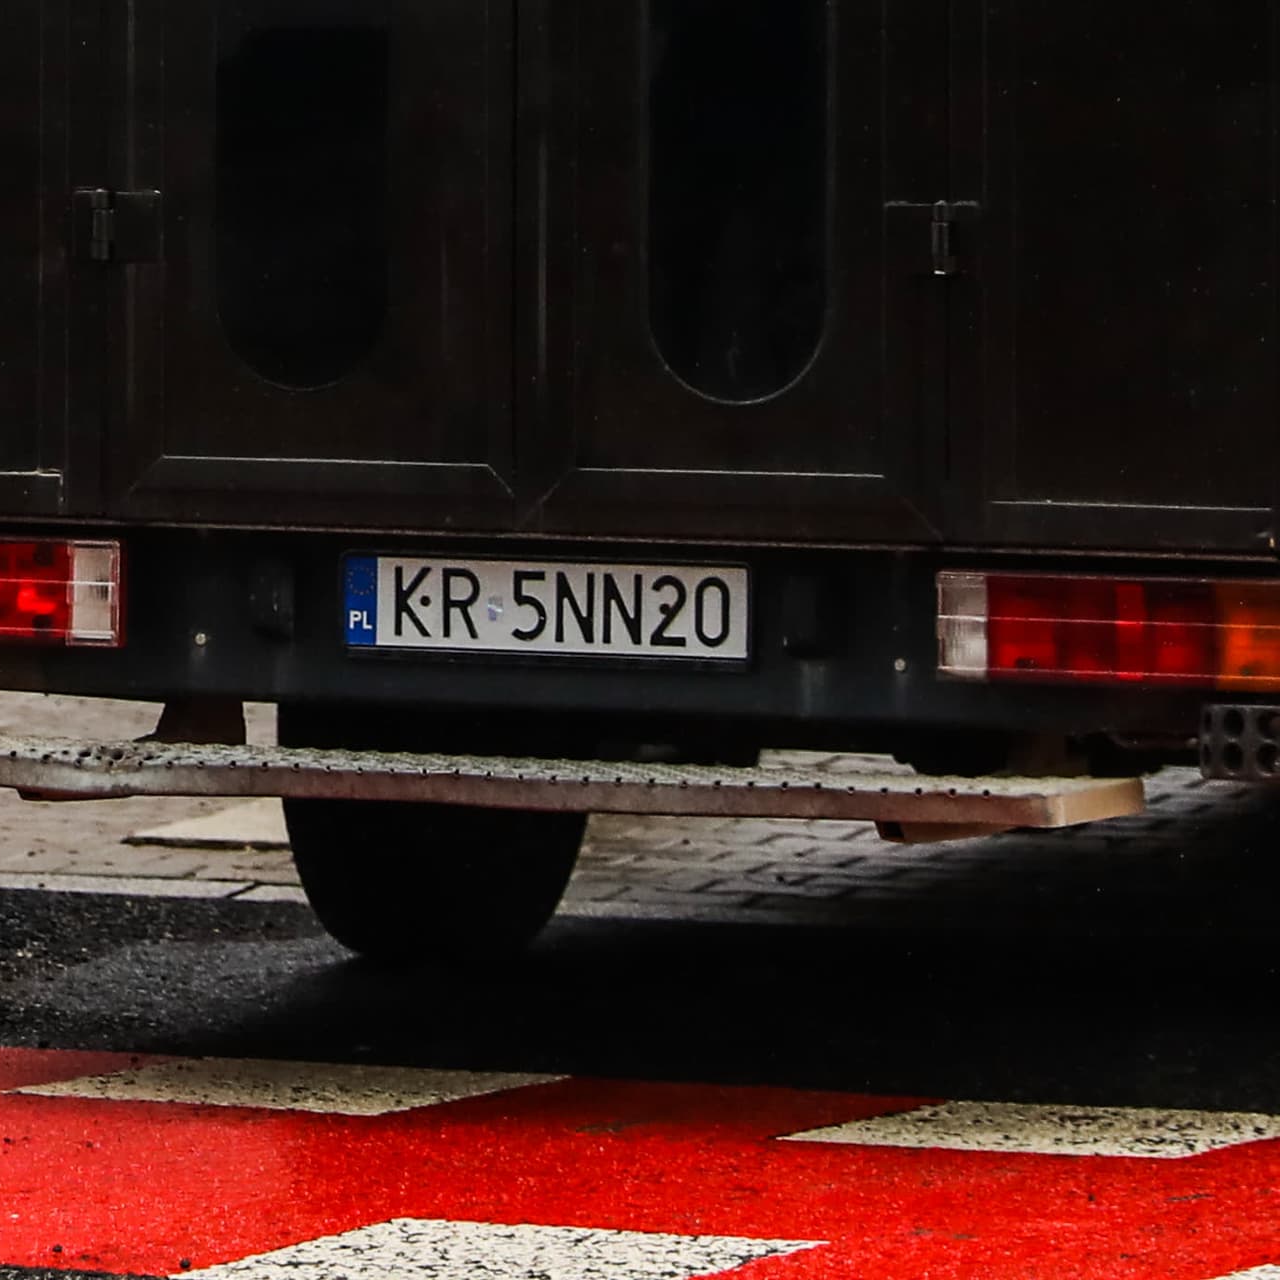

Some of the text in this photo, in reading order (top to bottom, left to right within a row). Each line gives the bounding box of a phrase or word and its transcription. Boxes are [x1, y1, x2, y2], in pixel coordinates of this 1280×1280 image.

[349, 610, 373, 630] PL
[394, 566, 731, 647] KR 5NN20
